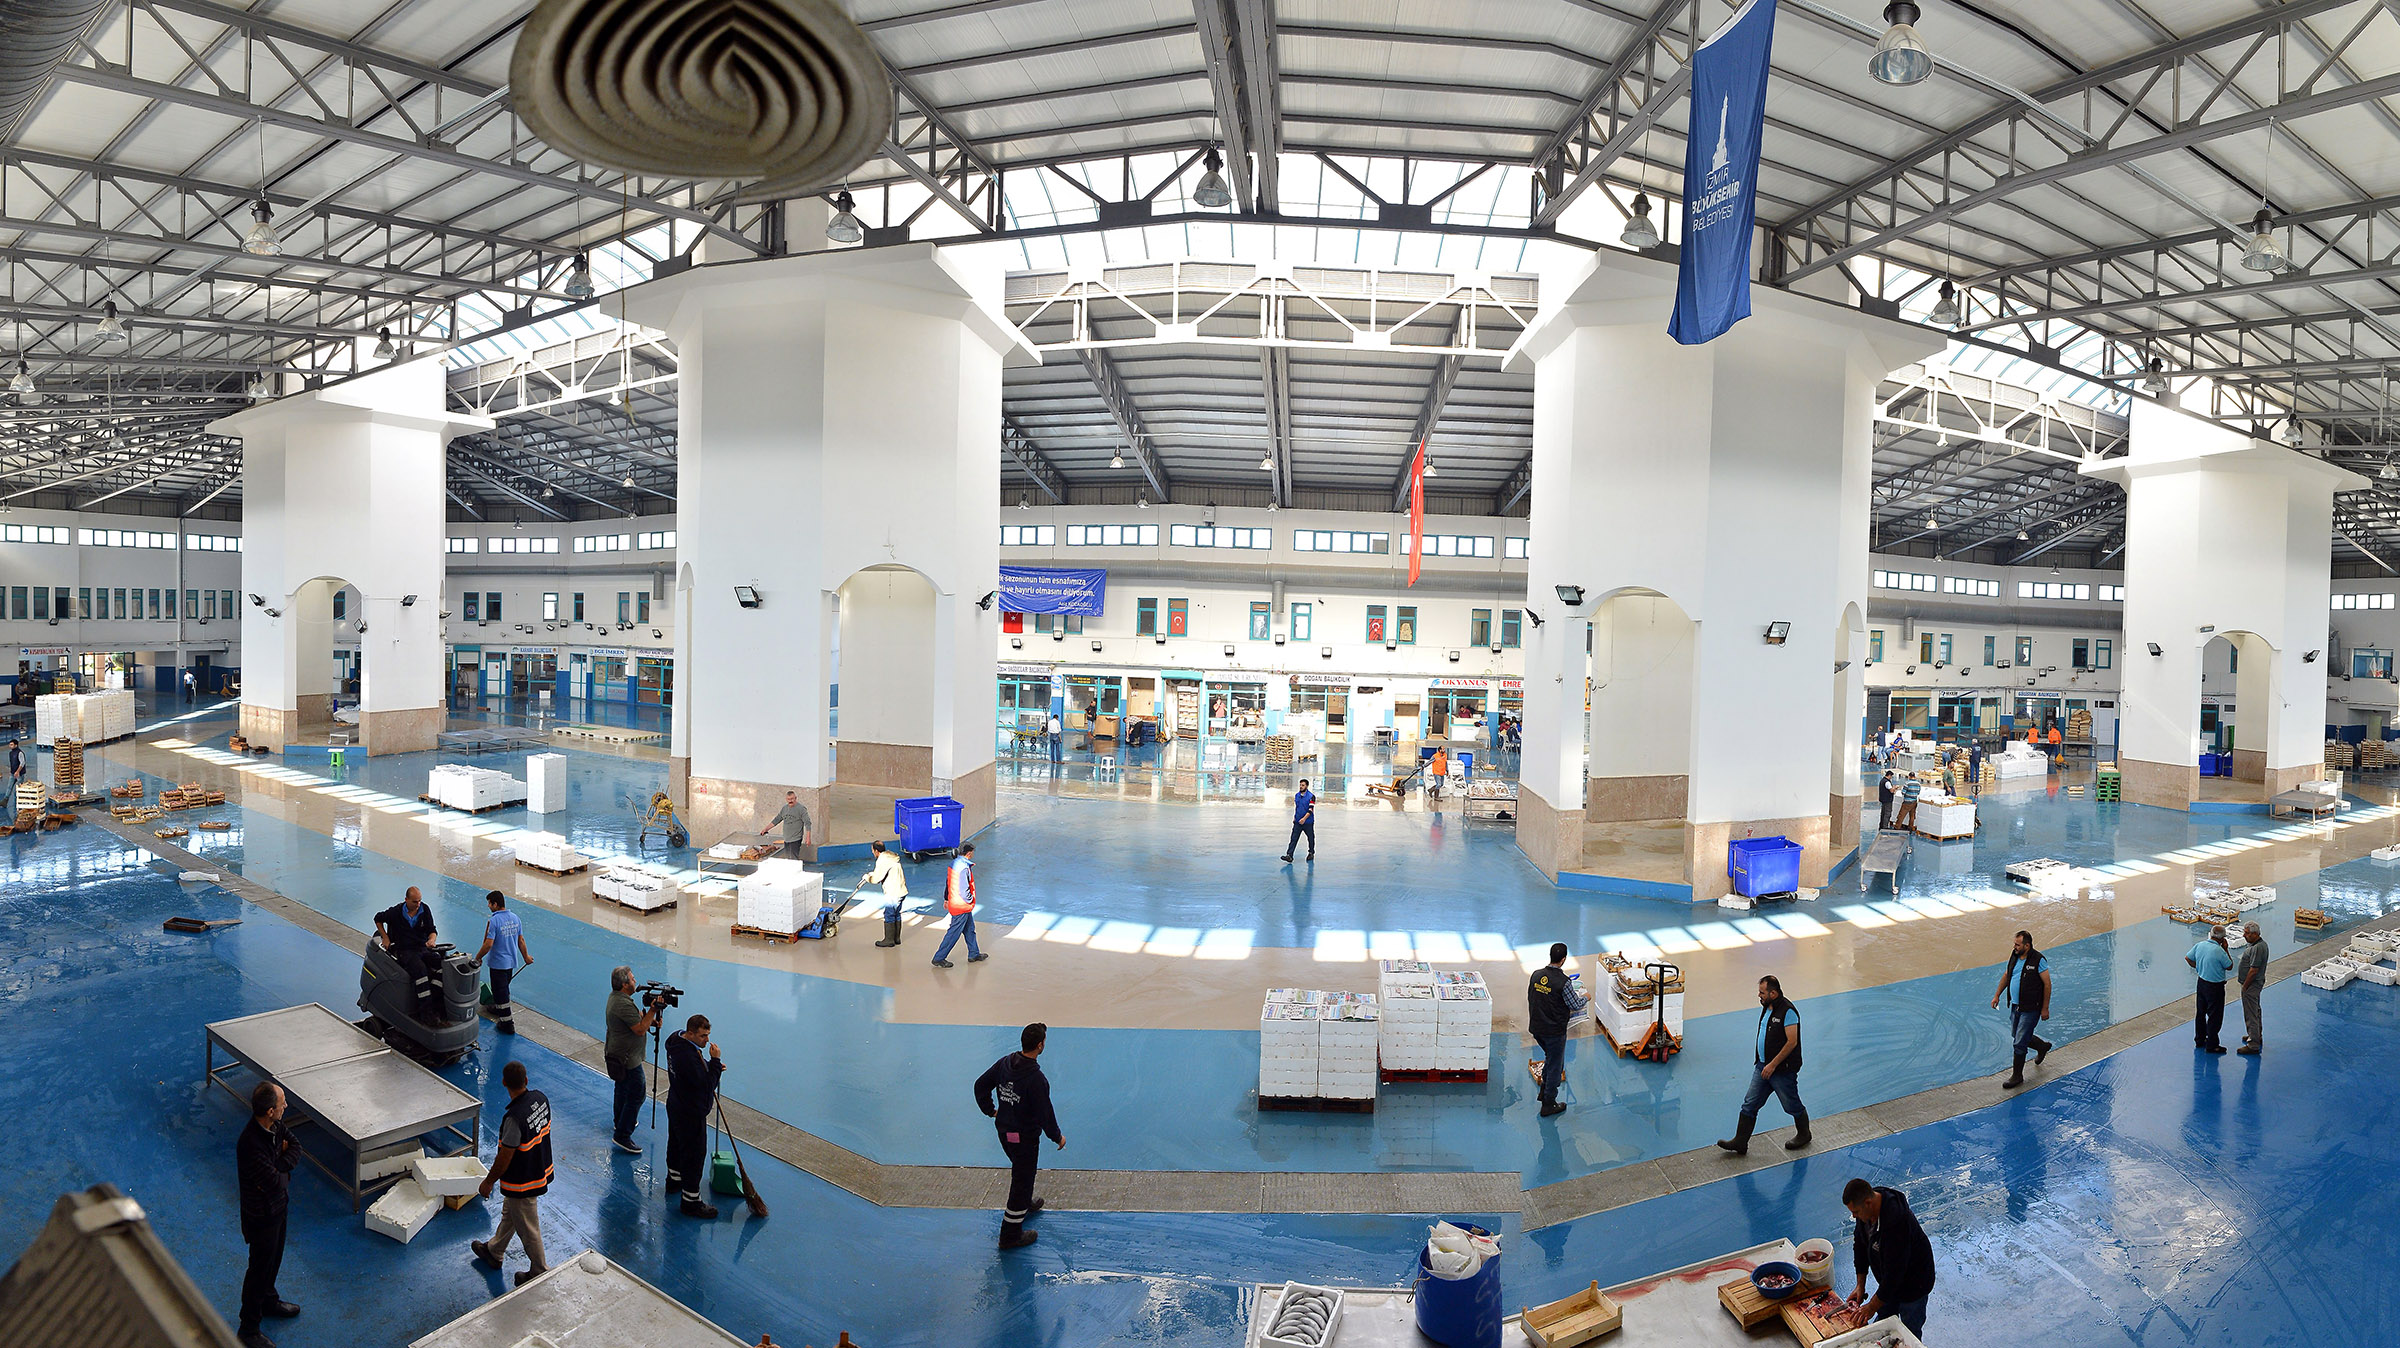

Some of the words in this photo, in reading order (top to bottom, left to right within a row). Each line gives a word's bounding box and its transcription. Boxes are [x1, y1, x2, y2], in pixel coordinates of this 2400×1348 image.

[1004, 575, 1038, 583] sezonunun
[1038, 576, 1051, 584] tüm
[1014, 585, 1035, 595] hayırlı
[1035, 587, 1062, 596] olmasını
[605, 648, 625, 656] İMREN
[1503, 680, 1522, 688] EMRE
